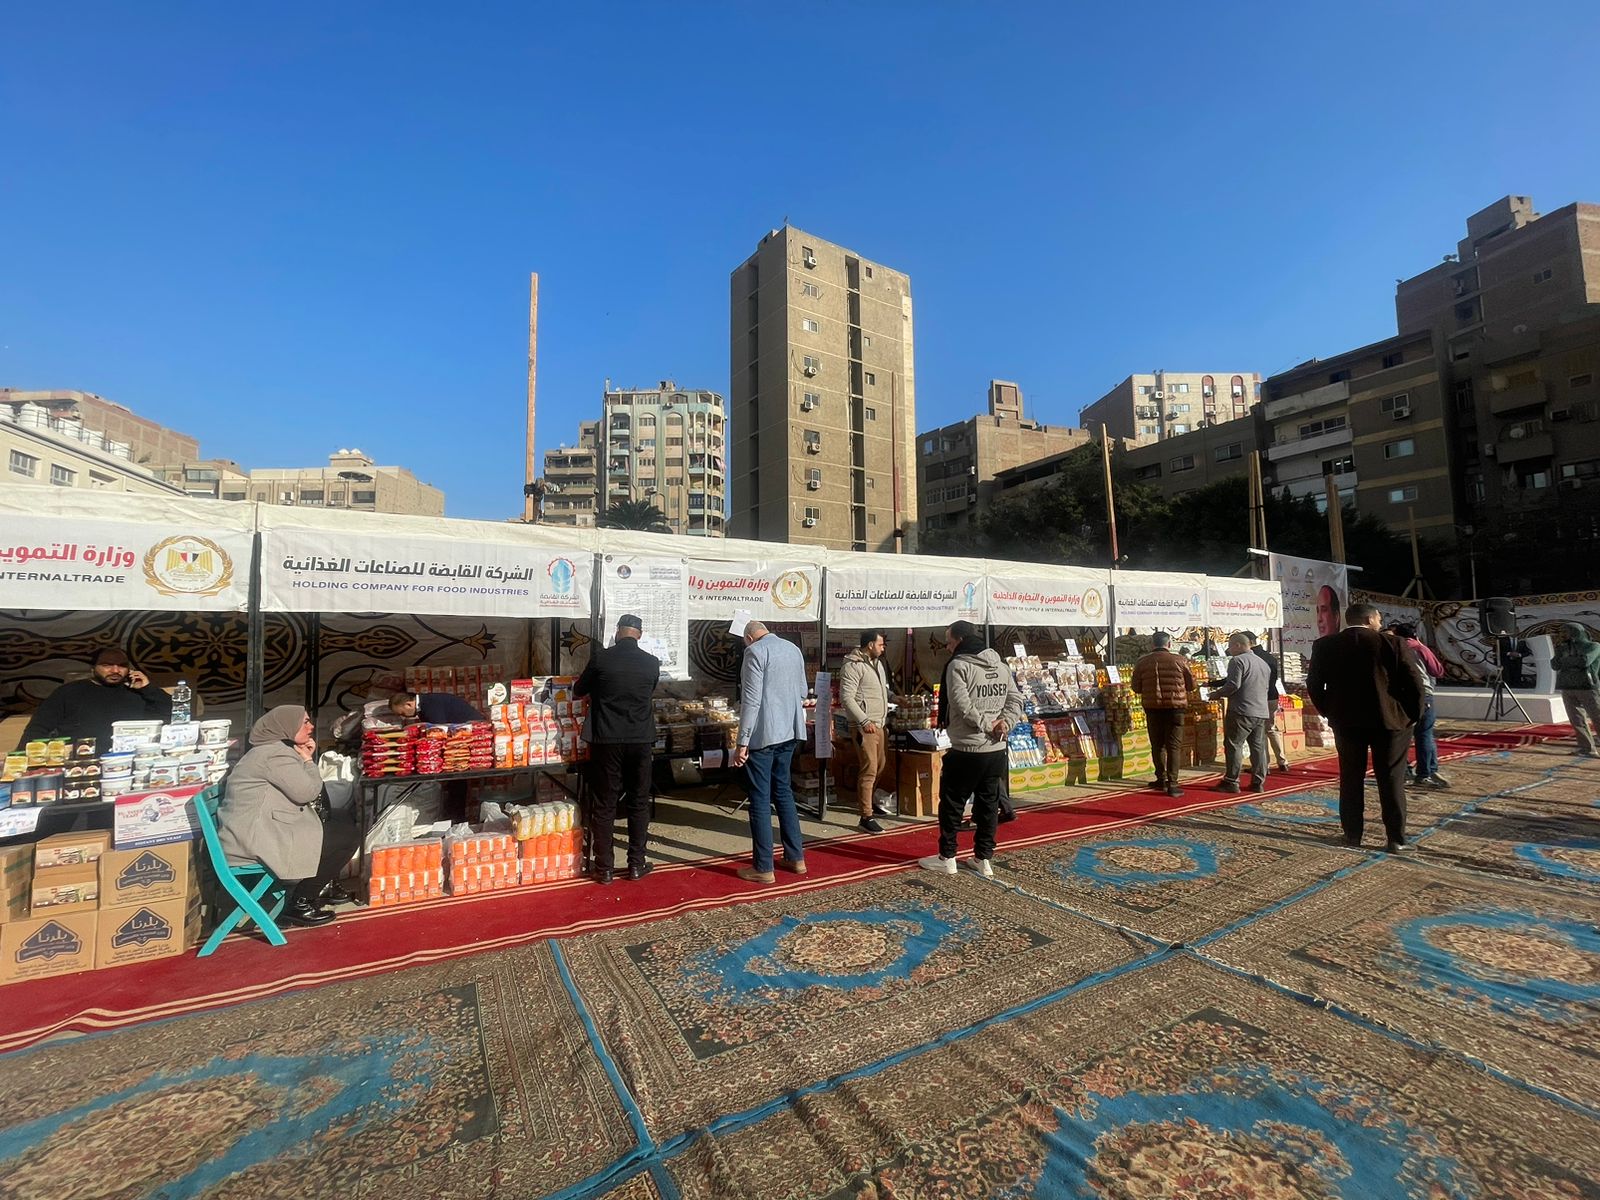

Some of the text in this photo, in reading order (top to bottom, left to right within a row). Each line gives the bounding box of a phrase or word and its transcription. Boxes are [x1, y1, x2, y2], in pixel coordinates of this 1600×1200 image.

[0, 543, 135, 568] وزارة التموي
[283, 555, 534, 583] الشركة القابضة للصناعات الغذائية
[293, 581, 348, 589] HOLDING
[352, 582, 409, 591] COMPANY
[469, 587, 529, 595] INDUSTRIES
[706, 578, 746, 590] التموين
[747, 578, 770, 591] وزارة
[835, 588, 957, 602] الشركة القابضة للصناعات الغذائية
[135, 860, 162, 872] بلدنا
[131, 916, 159, 929] بلدنا
